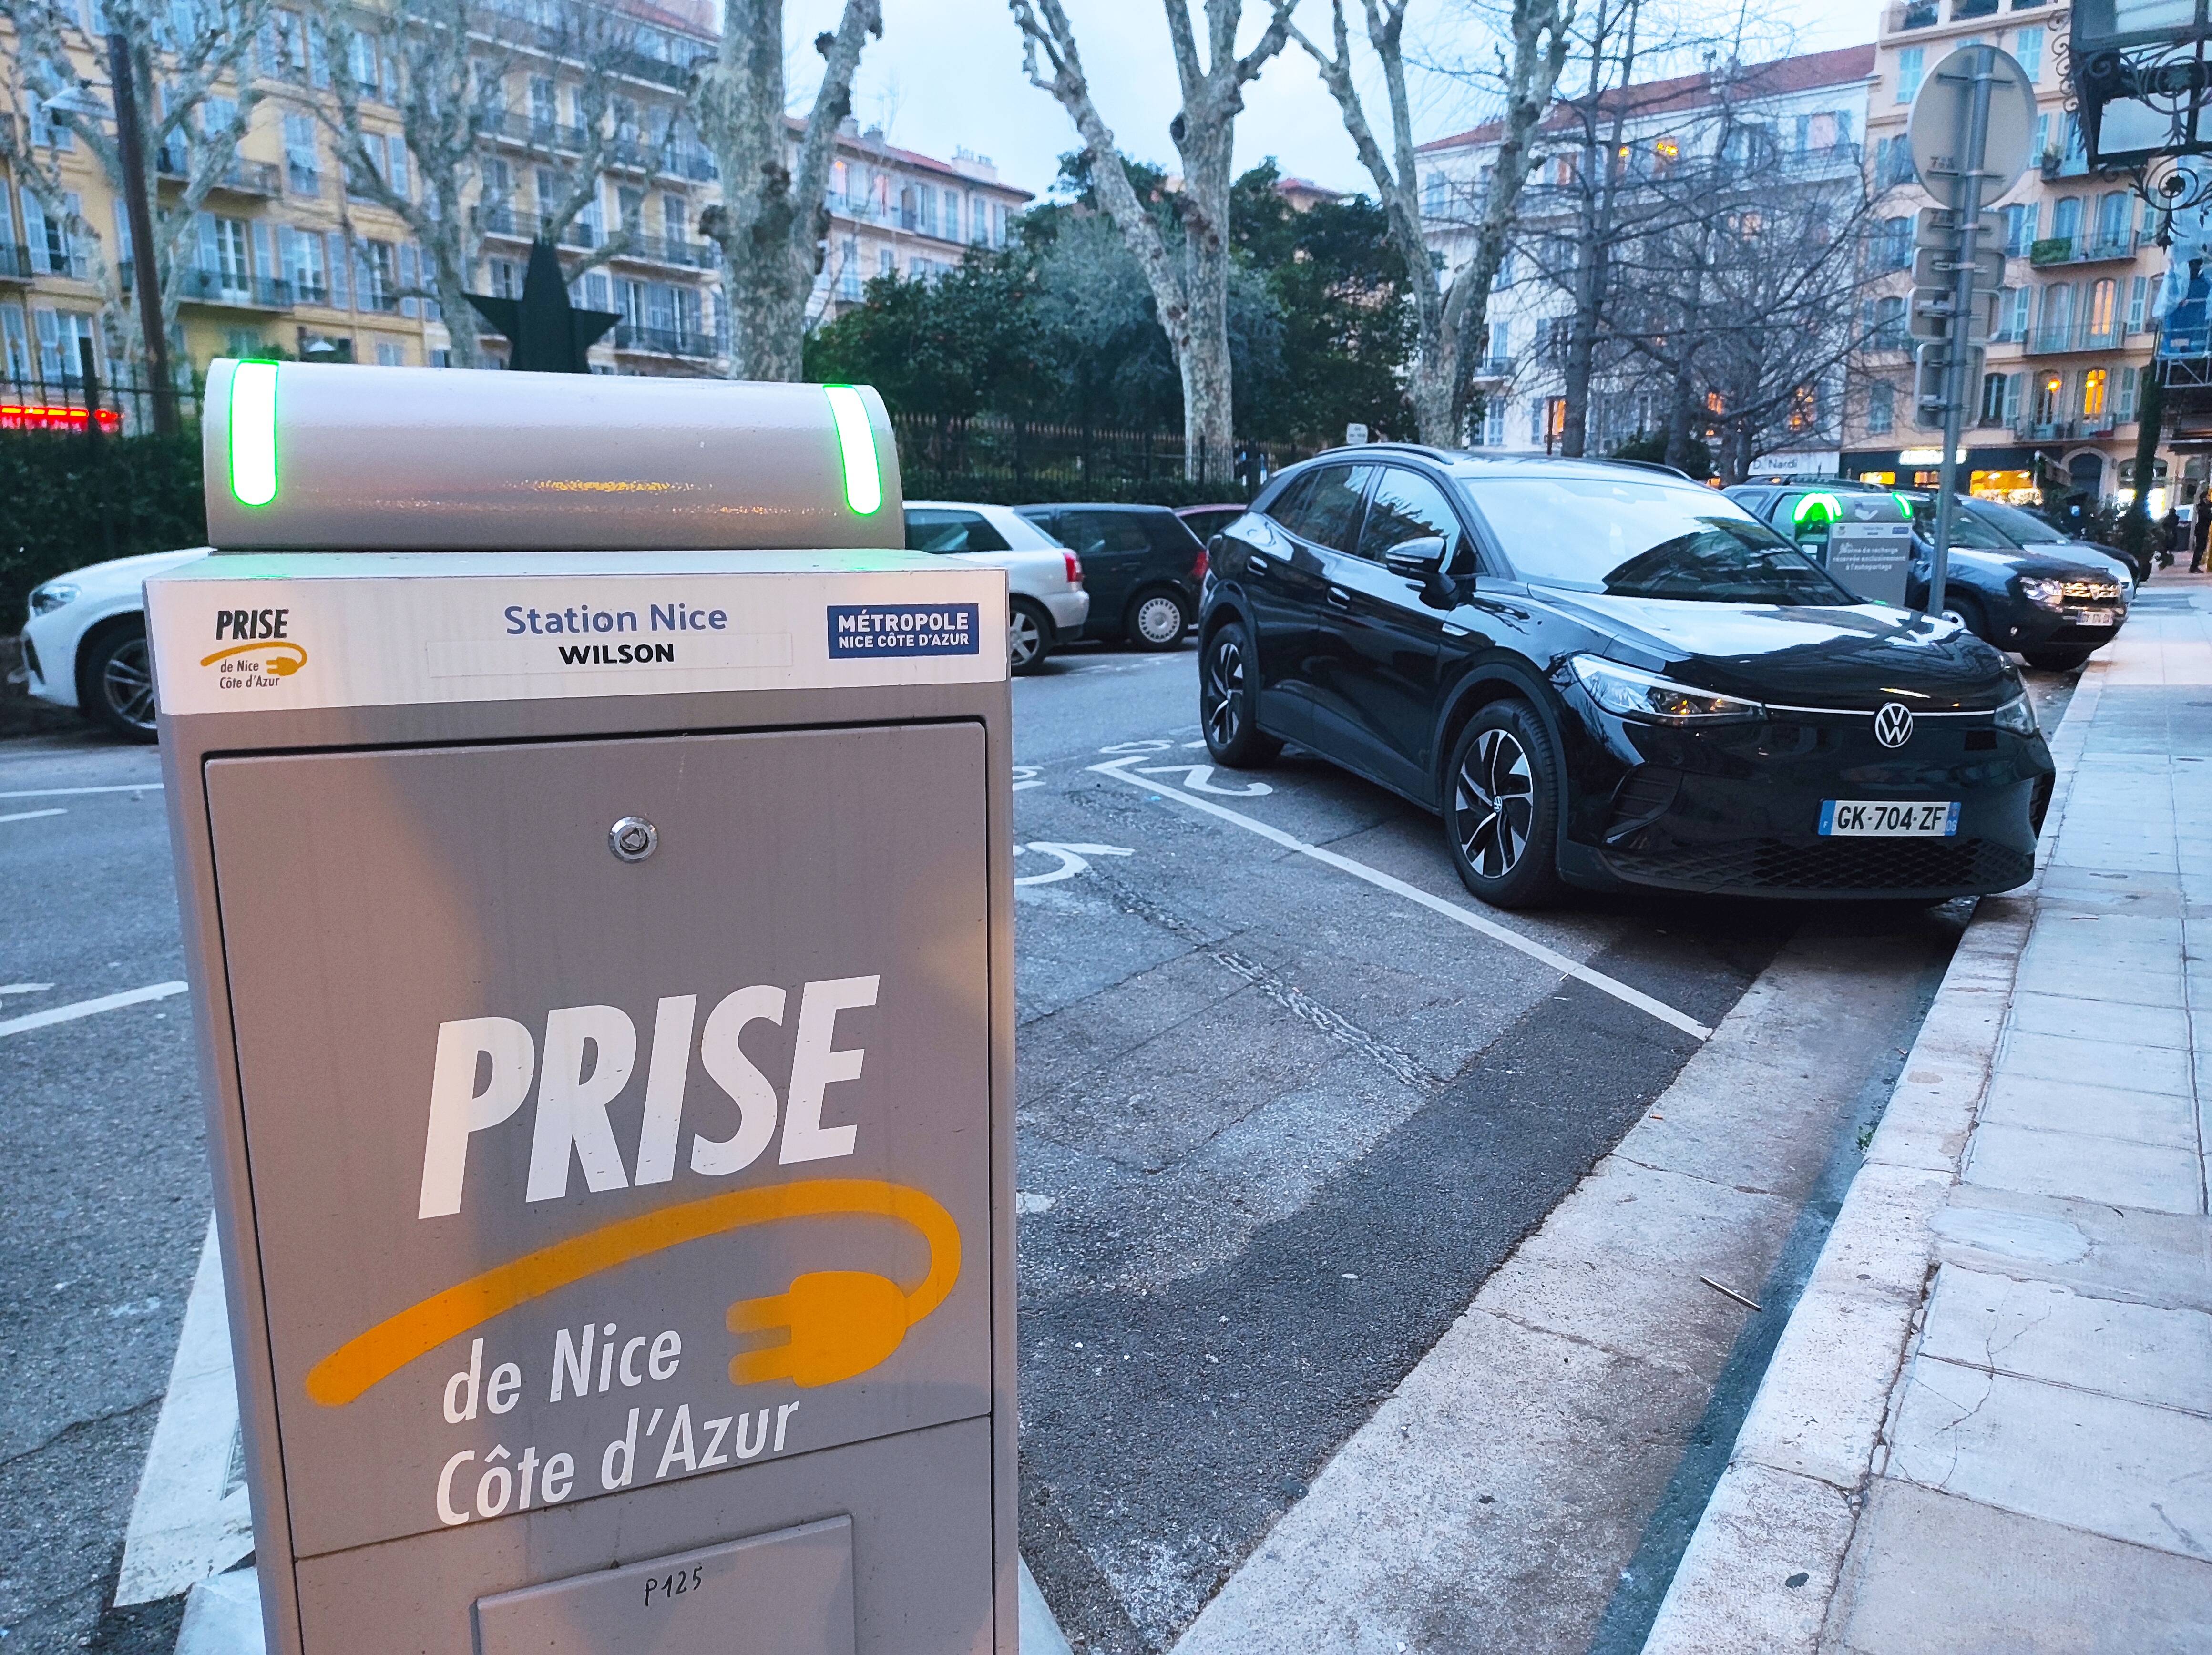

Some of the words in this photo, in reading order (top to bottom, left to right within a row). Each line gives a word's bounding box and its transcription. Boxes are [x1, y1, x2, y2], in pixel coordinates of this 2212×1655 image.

[216, 609, 289, 640] PRISE
[504, 604, 637, 634] Station
[650, 603, 727, 631] Nice
[838, 609, 969, 633] MÉTROPOLE
[558, 644, 674, 664] WILSON
[839, 635, 873, 648] NICE
[877, 632, 915, 647] CÔTE
[919, 633, 969, 647] D'AZUR
[220, 659, 233, 673] de
[237, 660, 259, 672] Nice
[220, 676, 242, 689] Côte
[246, 674, 280, 687] d'Azur
[1837, 806, 1946, 830] GK-704-ZF
[1946, 820, 1956, 831] 06
[419, 974, 881, 1219] PRISE
[443, 1338, 521, 1424] de
[550, 1323, 681, 1402] Nice
[436, 1444, 574, 1525] Côte
[601, 1400, 799, 1490] d'Azur
[644, 1566, 703, 1606] P125
